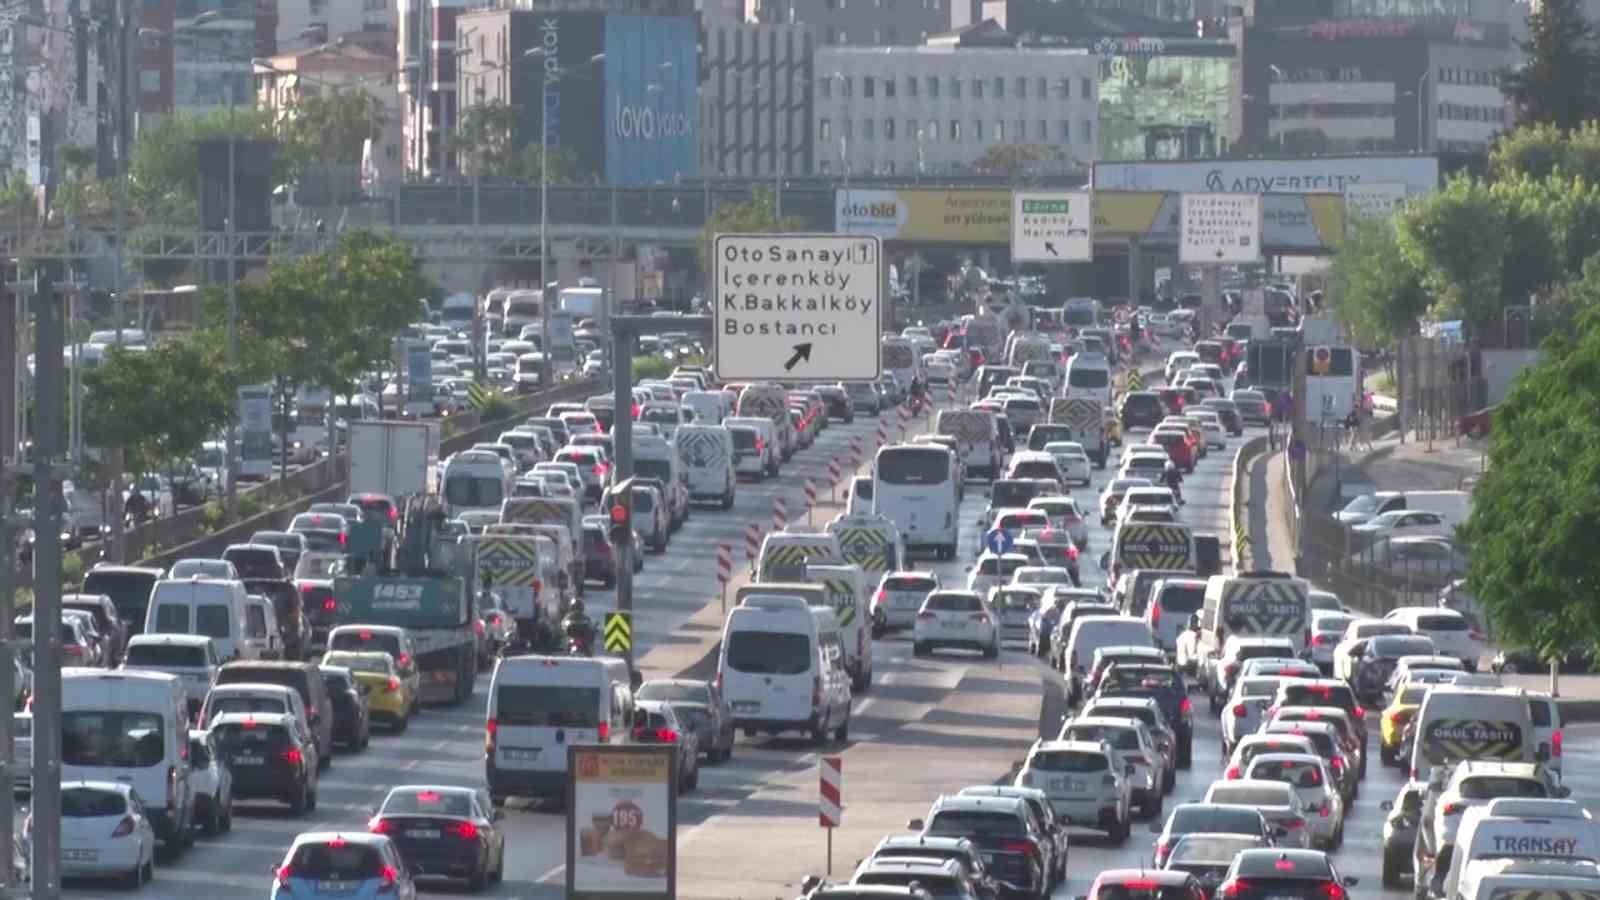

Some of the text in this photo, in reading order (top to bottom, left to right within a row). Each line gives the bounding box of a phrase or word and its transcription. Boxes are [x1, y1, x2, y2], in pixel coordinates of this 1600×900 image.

[724, 246, 763, 262] Oto
[769, 246, 851, 266] Sanayi
[724, 266, 850, 290] İçerenköy
[724, 294, 872, 315] K.Bakkalköy
[724, 319, 837, 335] Bostancı
[1434, 727, 1469, 739] OKUL
[1493, 836, 1577, 855] TRANSAY
